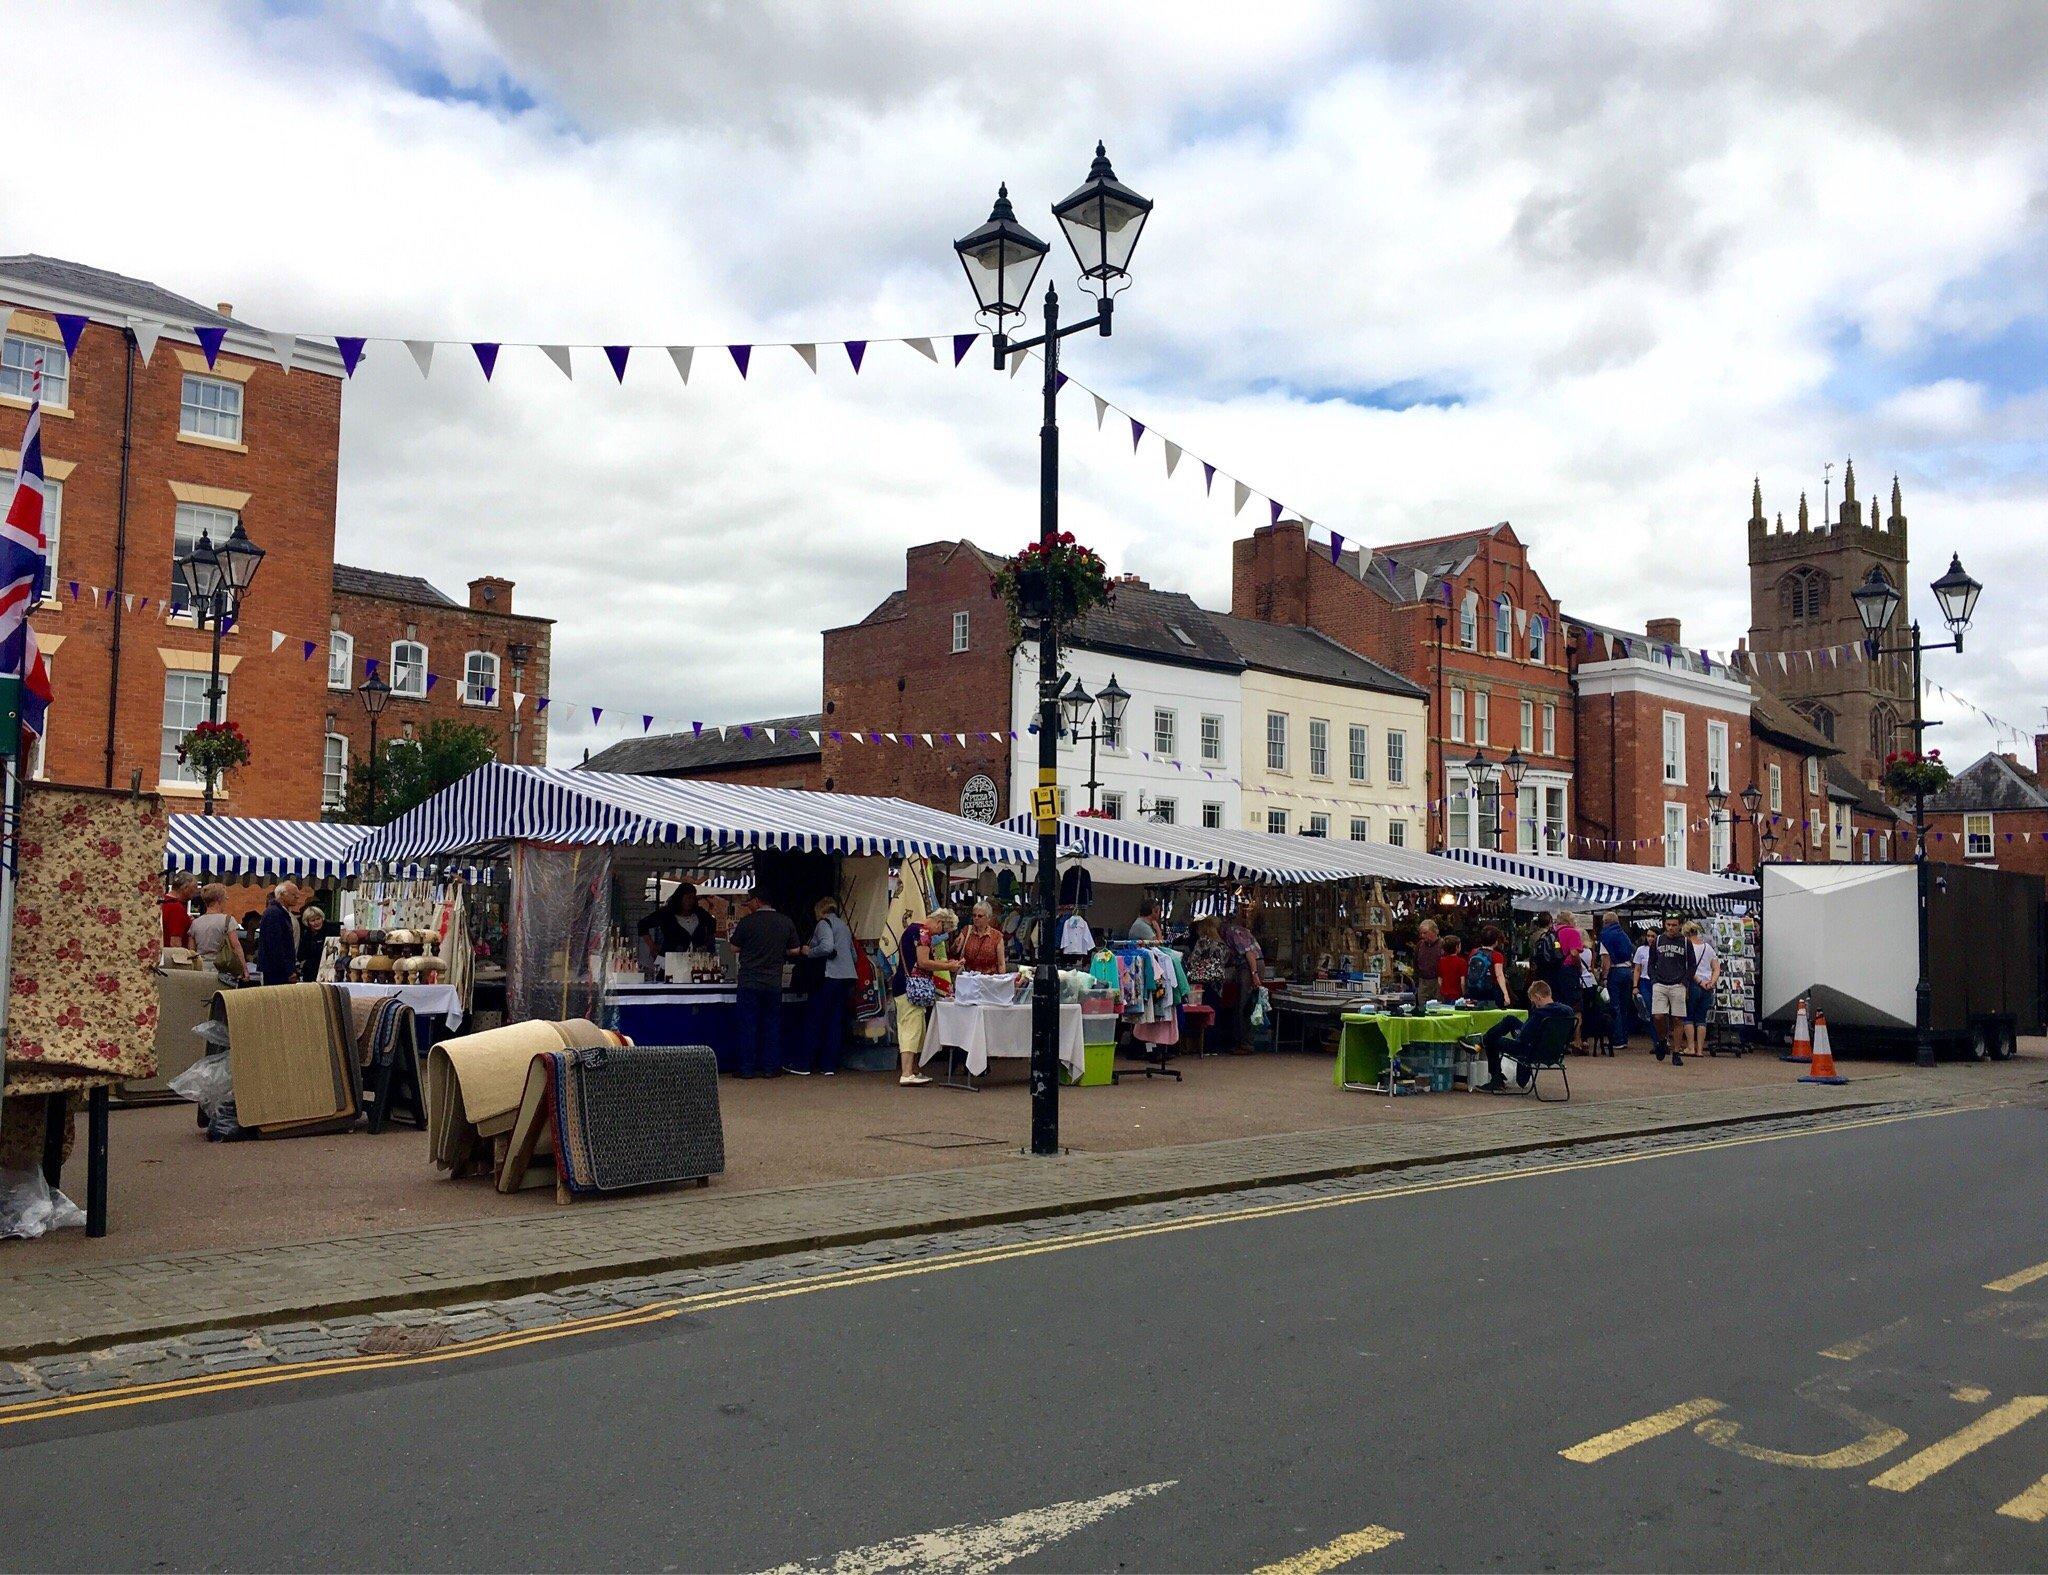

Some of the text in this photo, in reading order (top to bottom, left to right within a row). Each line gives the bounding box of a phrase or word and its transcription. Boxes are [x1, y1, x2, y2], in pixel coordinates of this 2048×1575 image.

[969, 793, 988, 801] PIZZA
[964, 800, 993, 809] EXPRESS
[1033, 789, 1056, 817] H
